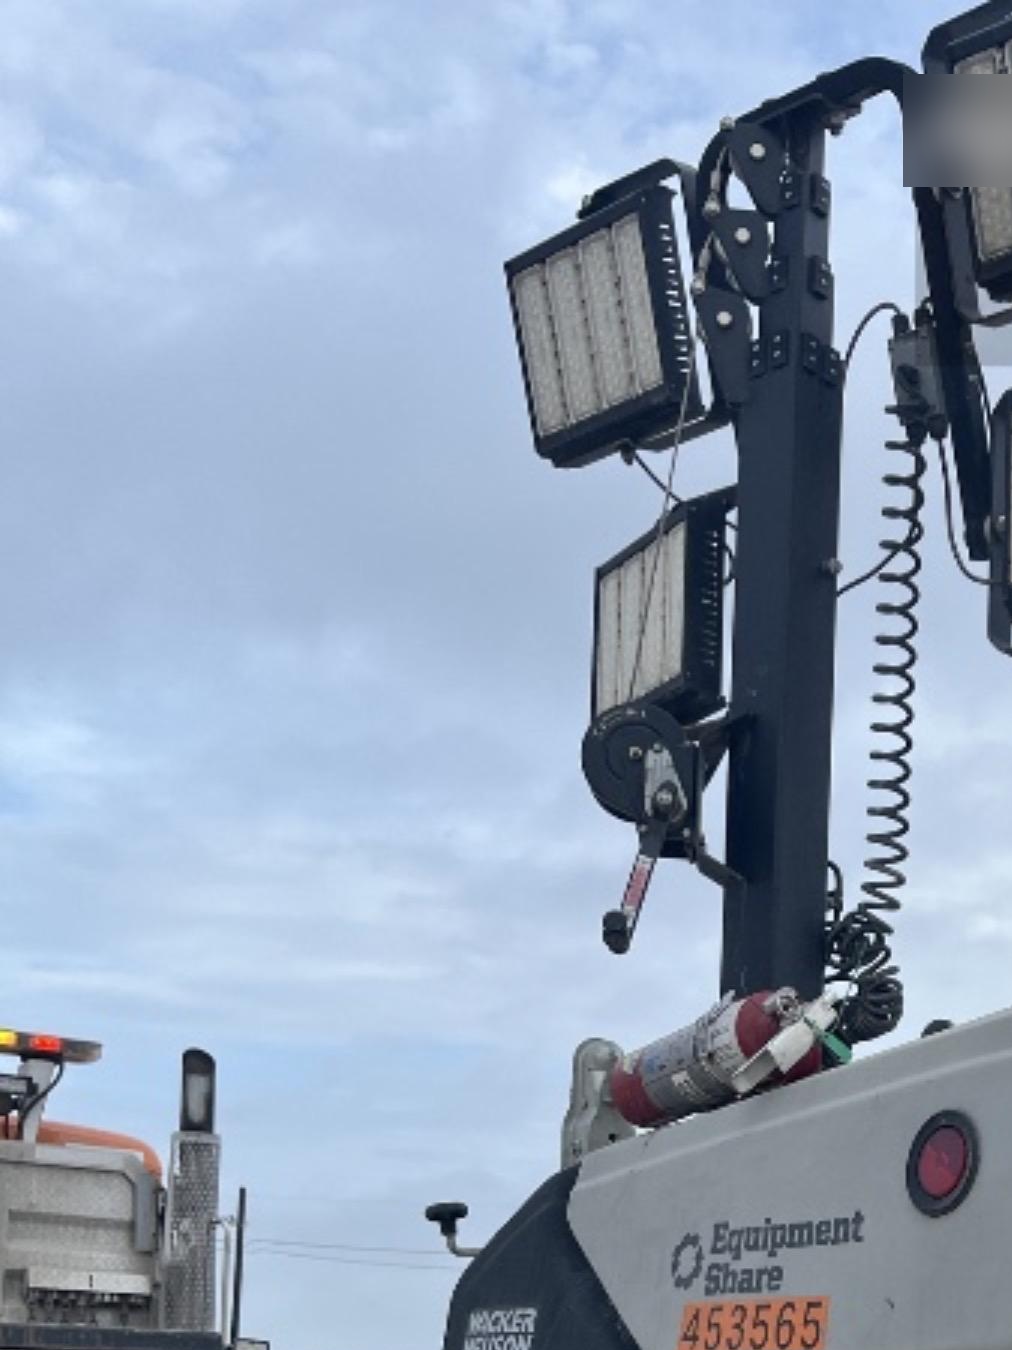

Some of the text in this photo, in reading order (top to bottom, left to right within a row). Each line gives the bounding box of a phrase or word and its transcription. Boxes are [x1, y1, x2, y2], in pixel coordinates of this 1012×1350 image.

[710, 1210, 865, 1257] Equipment
[704, 1262, 784, 1296] Share
[469, 1308, 537, 1334] WACKER
